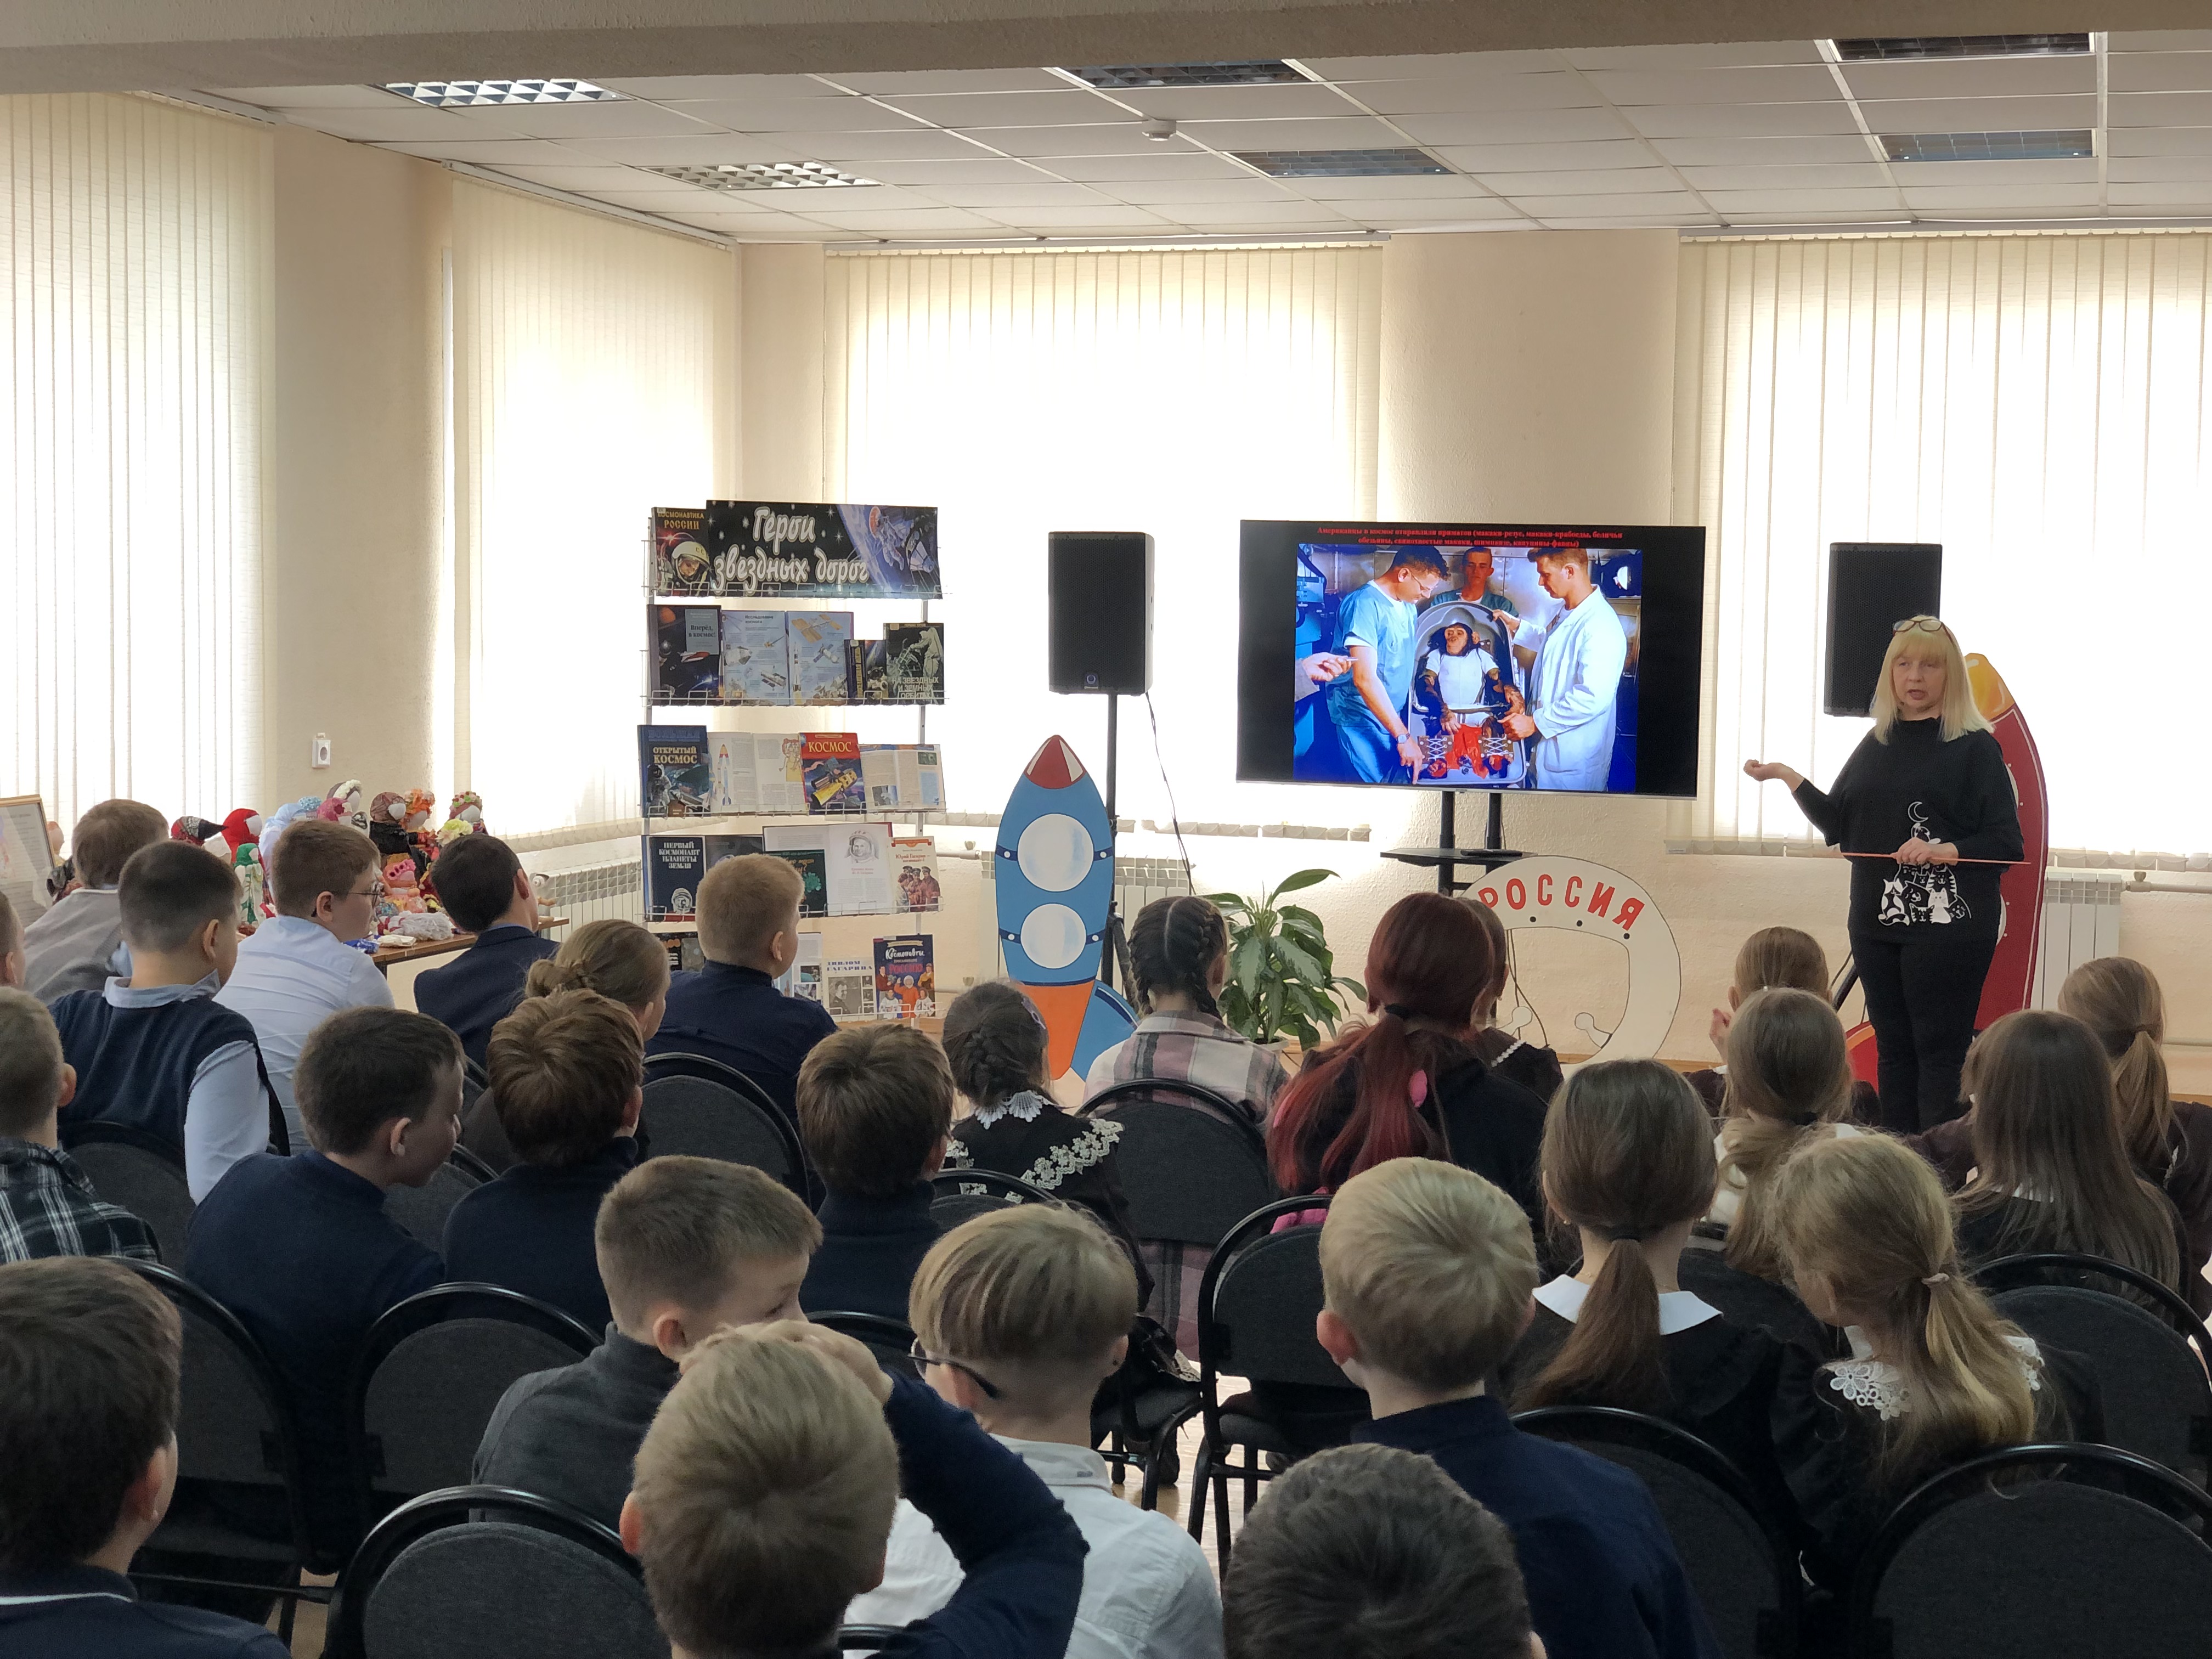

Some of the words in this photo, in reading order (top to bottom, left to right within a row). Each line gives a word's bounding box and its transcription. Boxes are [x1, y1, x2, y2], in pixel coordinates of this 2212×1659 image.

[664, 520, 700, 530] РОССИИ
[753, 506, 816, 555] Герои
[1317, 527, 1363, 535] Американцы
[713, 544, 809, 596] звездных
[814, 546, 870, 595] дорог
[808, 742, 853, 753] КОСМОС
[653, 754, 697, 764] КОСМОС
[1477, 874, 1645, 931] РОССИЯ
